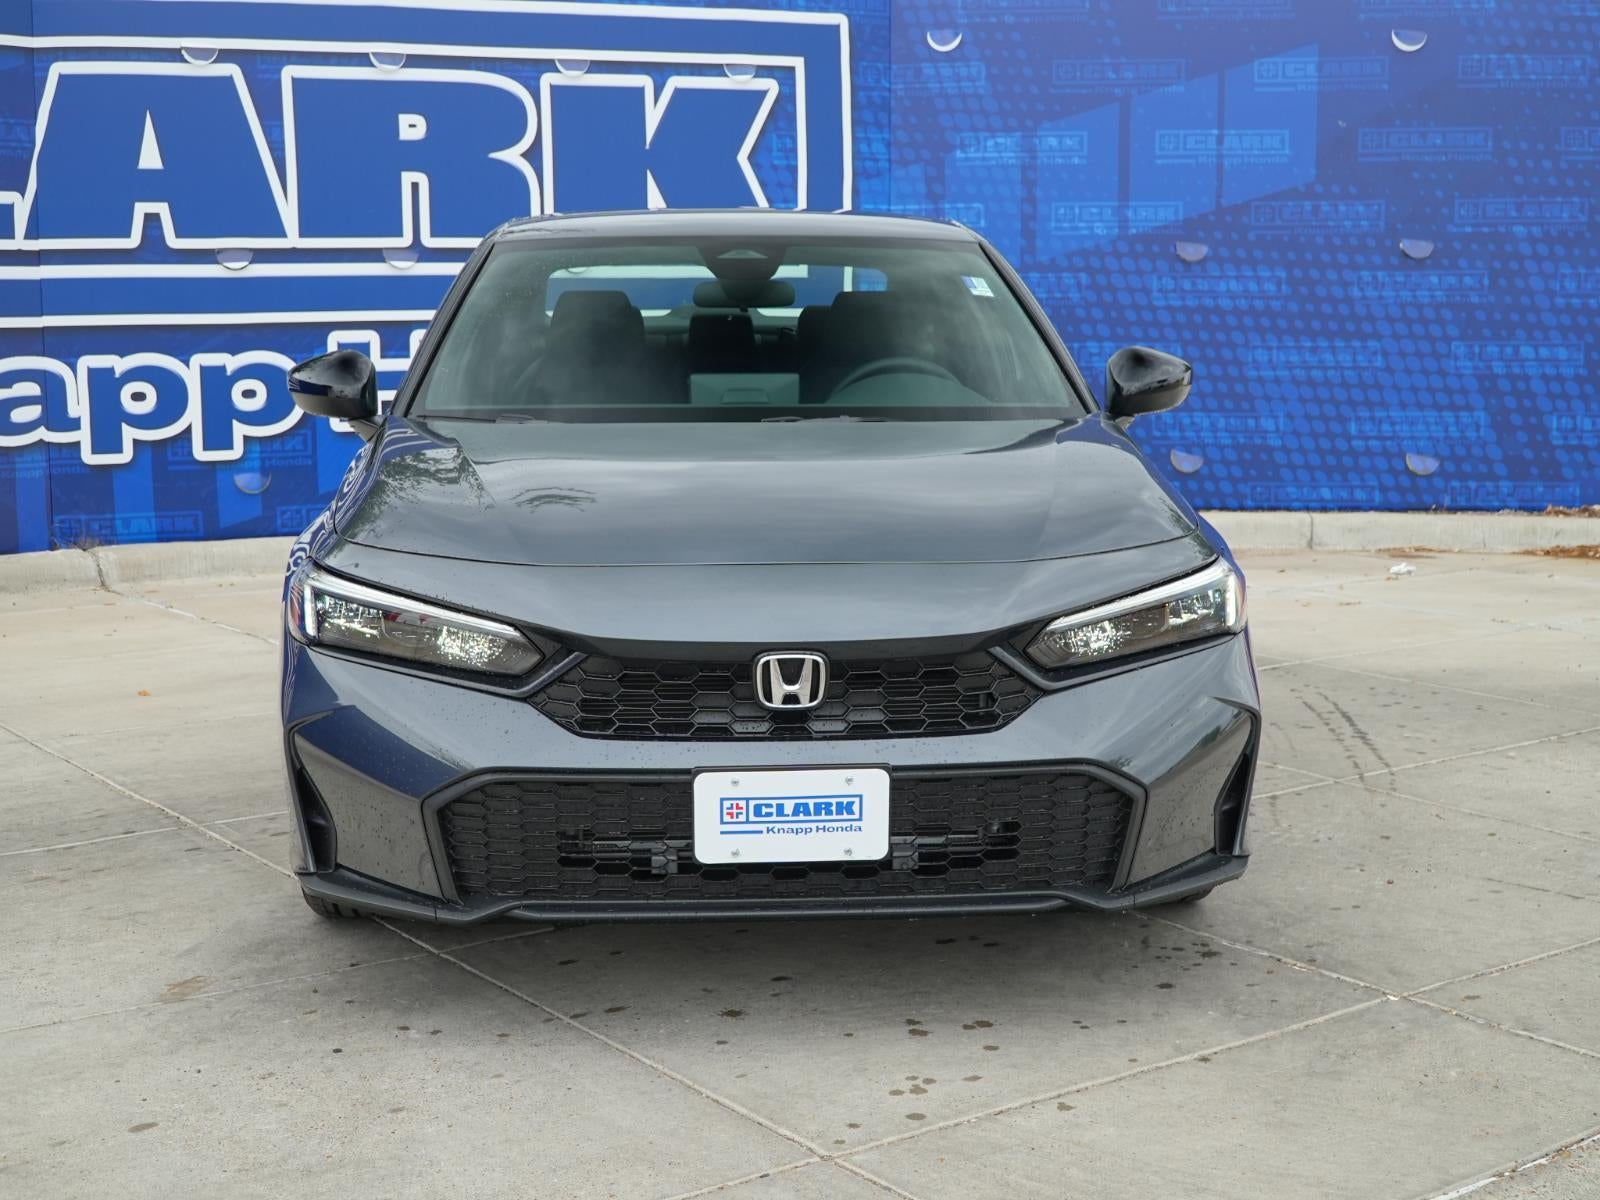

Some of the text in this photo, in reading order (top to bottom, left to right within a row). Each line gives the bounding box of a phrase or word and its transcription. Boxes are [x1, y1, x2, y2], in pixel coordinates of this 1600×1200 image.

[0, 60, 779, 250] ARK
[753, 801, 856, 818] CLARK
[766, 824, 862, 836] Knapp Honda
